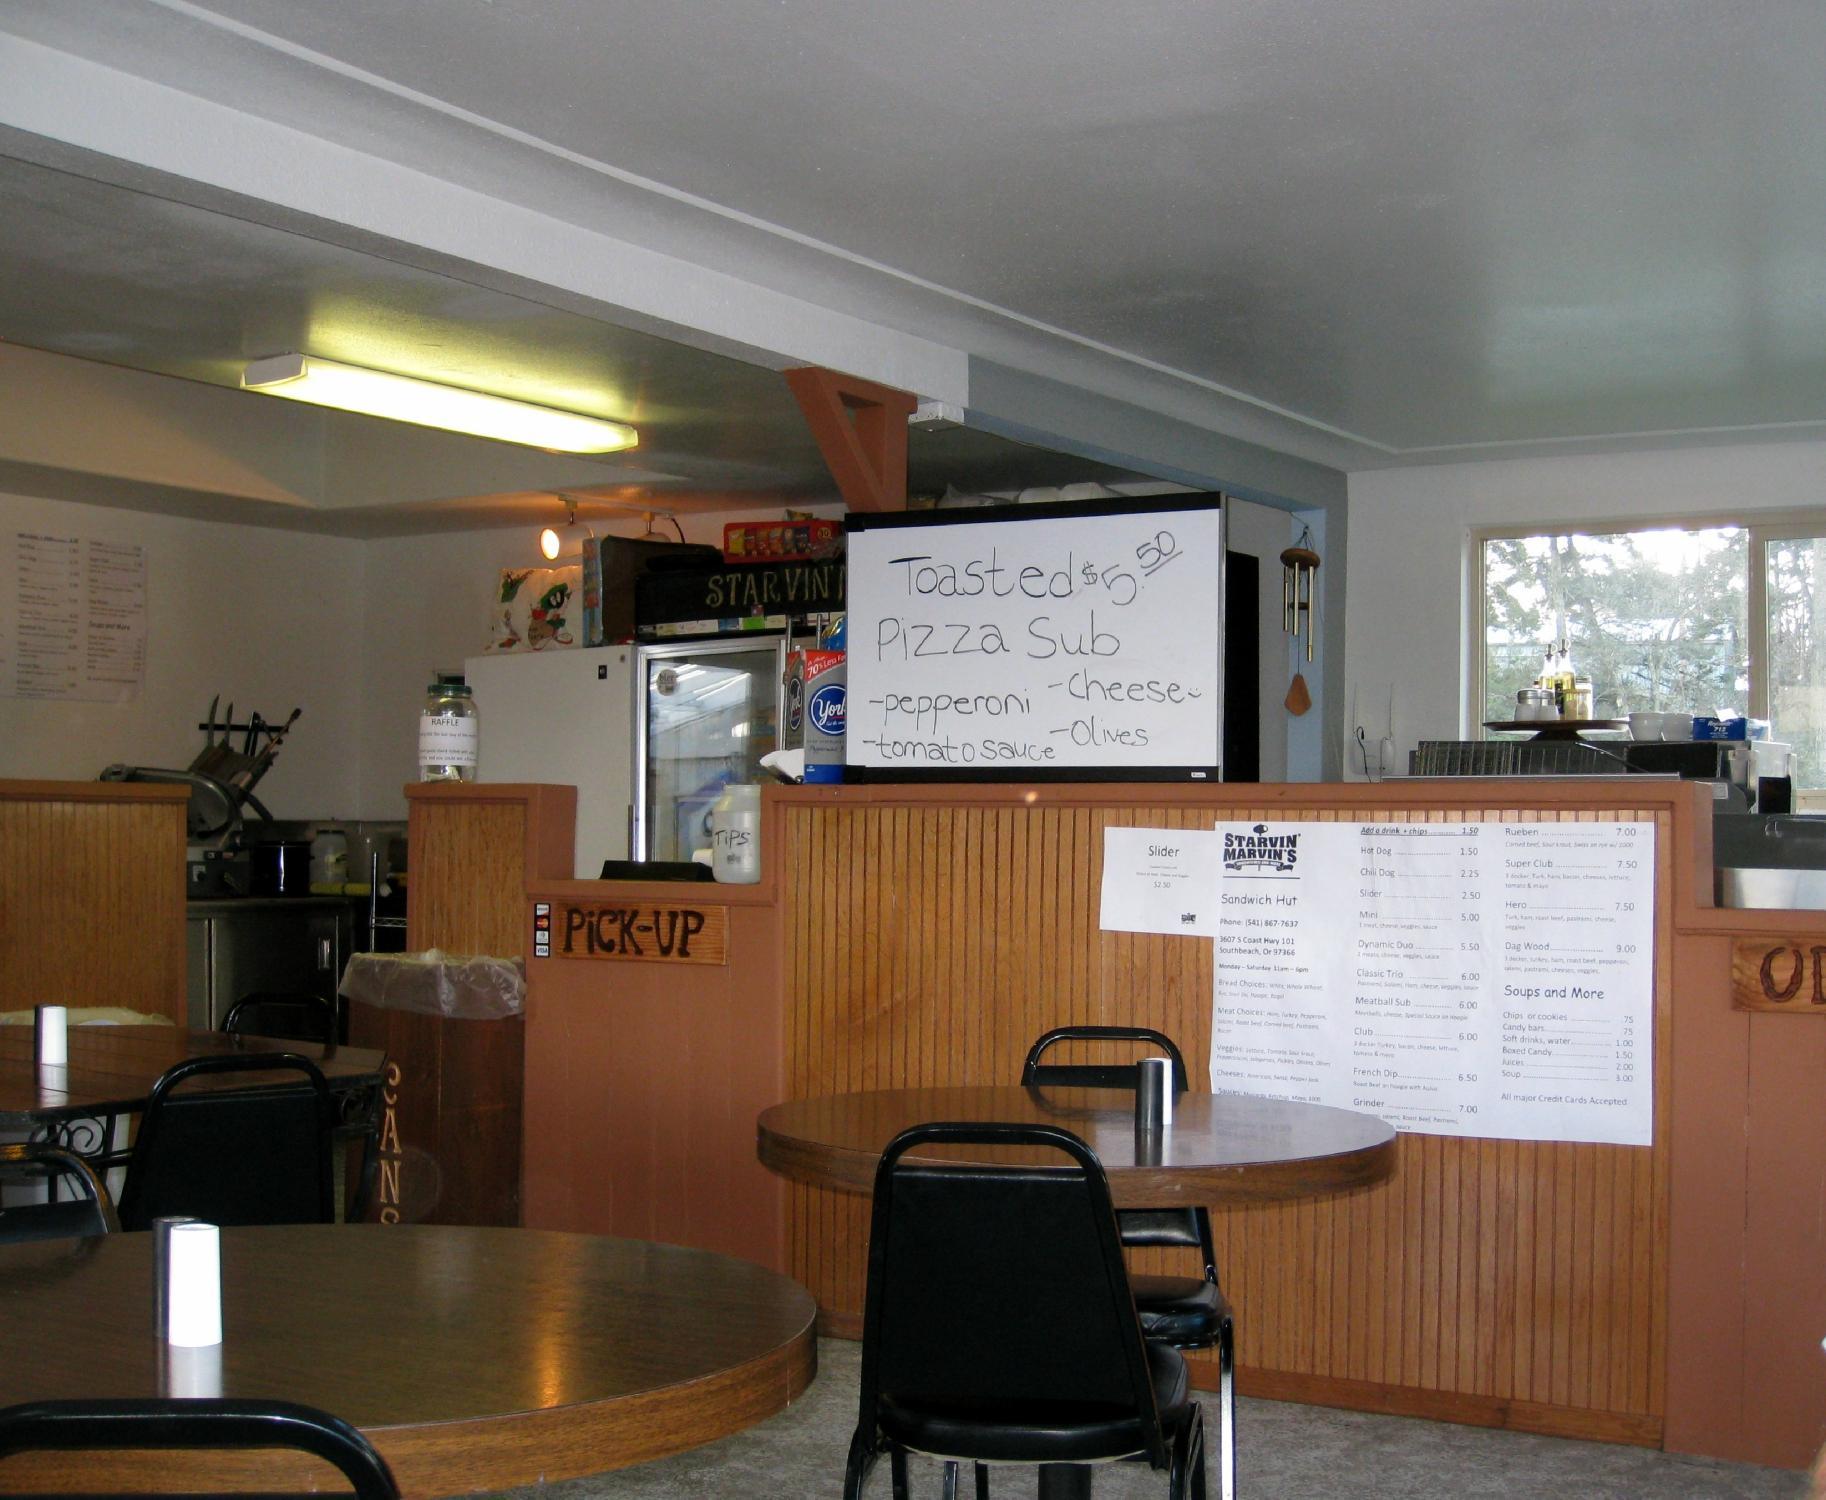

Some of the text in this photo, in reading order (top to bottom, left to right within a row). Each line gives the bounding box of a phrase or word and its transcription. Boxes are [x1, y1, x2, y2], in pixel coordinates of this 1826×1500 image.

[889, 547, 1073, 598] Toasted
[878, 610, 1121, 661] Pizza Sub
[431, 718, 459, 727] RAFFLE
[1360, 827, 1375, 835] Add
[1381, 827, 1400, 835] drink
[1408, 827, 1428, 836] chips
[1461, 827, 1479, 835] 1.50
[1505, 828, 1637, 837] Rueben 7.00
[1148, 845, 1180, 858] Slider
[1223, 848, 1297, 863] MARVIN'S
[1360, 846, 1478, 857] Hot Dog 1.50
[1505, 859, 1638, 869] Super Club 7.50
[1360, 868, 1480, 878] Chili Dog 2.25
[1221, 894, 1299, 906] Sandwich Hut
[1360, 888, 1481, 900] Slider 2.50
[1505, 901, 1635, 912] Hero 7.50
[1359, 911, 1480, 922] Mini 5.00
[1245, 919, 1263, 928] (541)
[1264, 920, 1299, 928] 867-7637
[1264, 937, 1280, 946] Hwy
[1358, 939, 1480, 951] Dynamic Duo 5.50
[1505, 942, 1637, 953] Dag Wood 9.00
[1219, 947, 1262, 956] Southbeach,
[1218, 963, 1241, 971] Monday
[1356, 968, 1480, 981] Classic Trio 6.00
[1504, 985, 1605, 999] Soups and More
[1355, 996, 1478, 1010] Meatball Sub 6.00
[1502, 1011, 1523, 1021] Chips
[1537, 1012, 1568, 1021] cookies
[1354, 1027, 1478, 1041] Club 6.00
[1502, 1023, 1526, 1033] Candy
[1528, 1024, 1545, 1032] bars
[1502, 1034, 1518, 1042] Soft
[1519, 1036, 1546, 1046] drinks,
[1615, 1039, 1634, 1047] 1.00
[1502, 1046, 1633, 1059] Boxed Candy 1.50
[1502, 1058, 1634, 1071] Juices 2.00
[1353, 1067, 1478, 1082] French Dip 6.50
[1501, 1069, 1634, 1082] Soup 3.00
[1353, 1098, 1478, 1114] Grinder 7.00
[1501, 1093, 1628, 1107] All major Credit Cards Accepted
